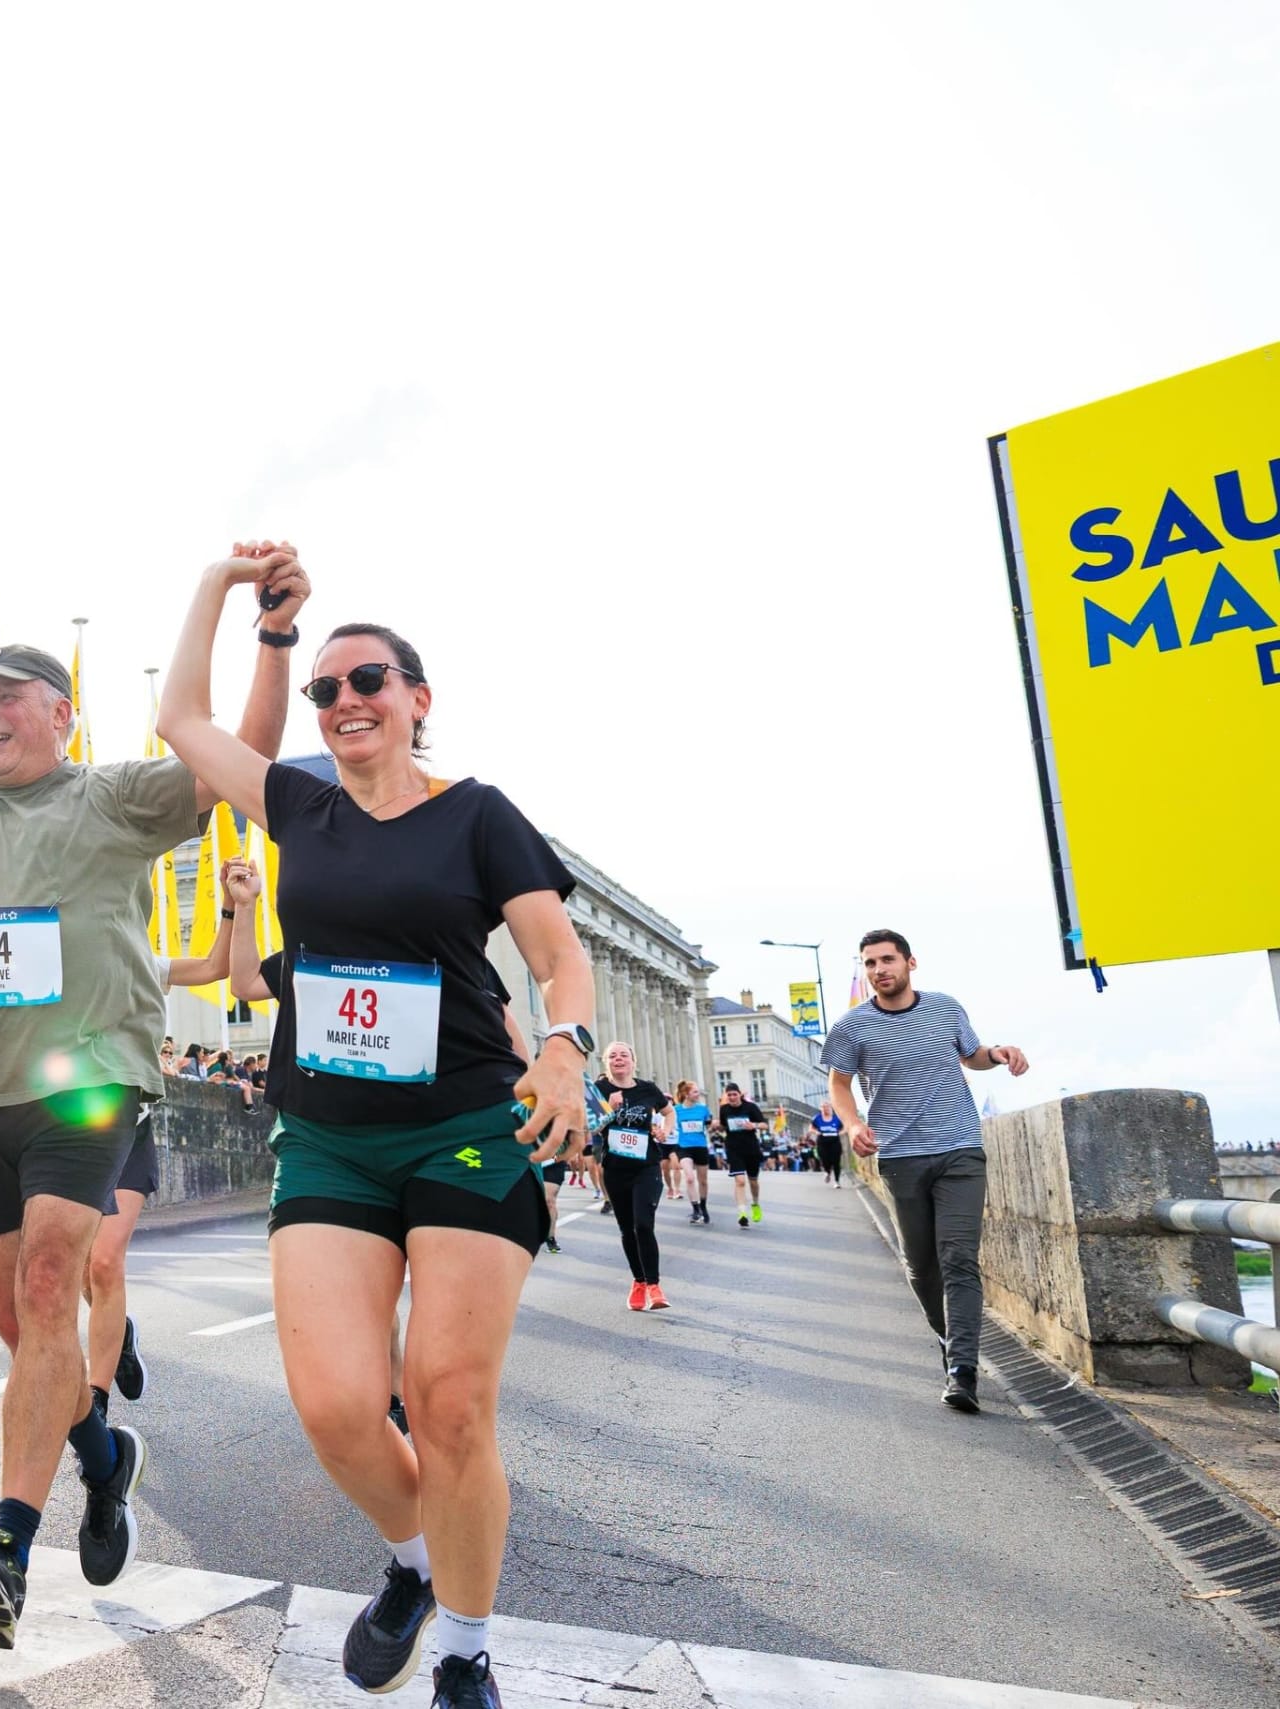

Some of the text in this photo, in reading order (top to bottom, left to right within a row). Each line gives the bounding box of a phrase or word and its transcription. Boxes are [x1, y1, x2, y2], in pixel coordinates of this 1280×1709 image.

[1083, 547, 1280, 669] MA
[331, 964, 377, 975] matmut
[338, 987, 378, 1030] 43
[327, 1029, 391, 1050] MARIE ALICE
[620, 1133, 638, 1146] 996
